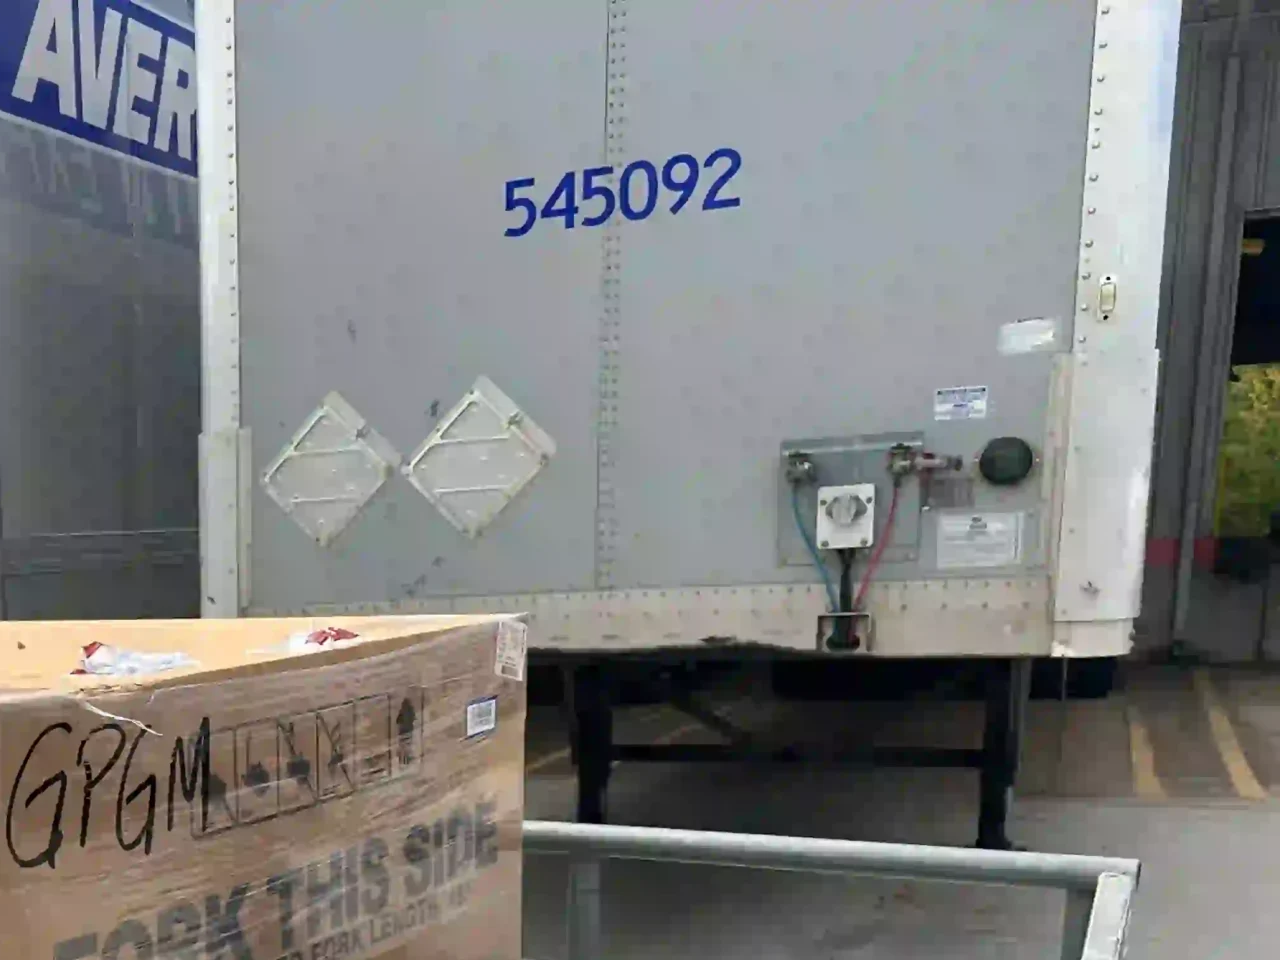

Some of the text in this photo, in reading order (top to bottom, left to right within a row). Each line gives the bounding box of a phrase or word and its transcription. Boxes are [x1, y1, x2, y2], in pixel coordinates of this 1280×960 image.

[504, 148, 742, 237] 545092
[6, 716, 210, 869] GPGM
[267, 834, 390, 949] THIS
[403, 801, 499, 889] SIDE
